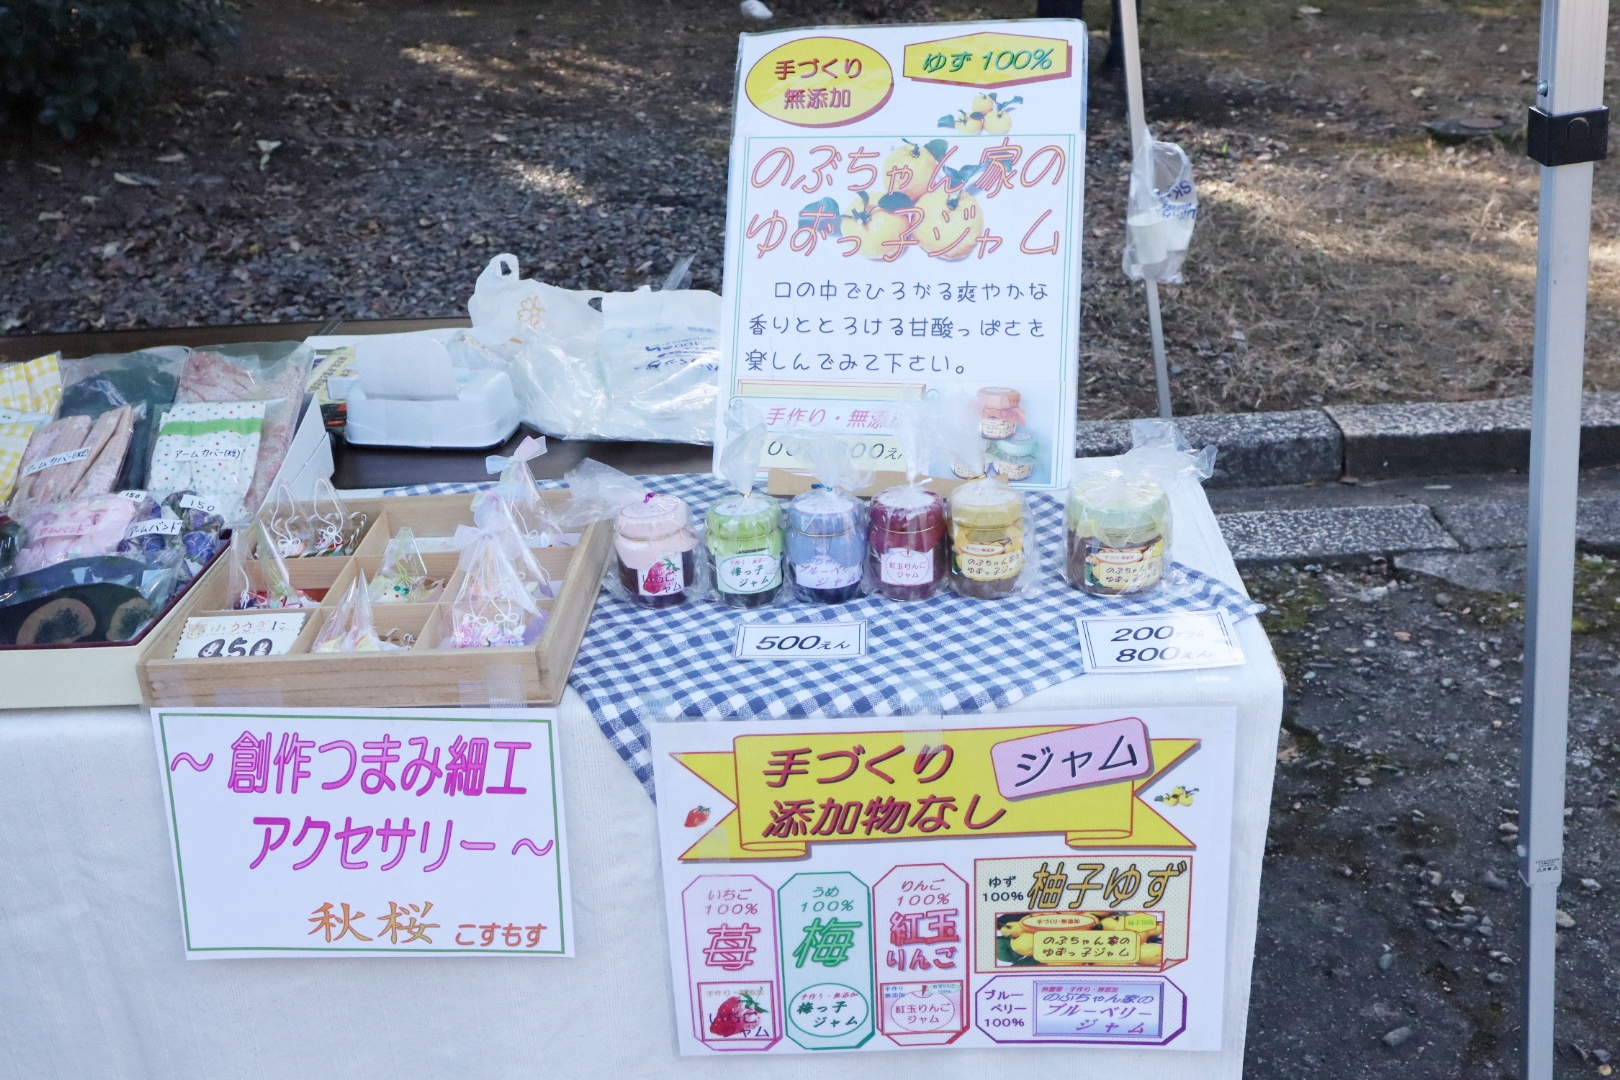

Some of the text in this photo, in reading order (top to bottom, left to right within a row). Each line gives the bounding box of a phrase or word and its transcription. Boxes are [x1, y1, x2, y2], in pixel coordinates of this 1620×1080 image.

[923, 47, 1054, 73] ゆず 100%
[774, 57, 863, 80] 手づくり
[783, 87, 851, 109] 無添加
[750, 137, 1066, 199] のぶちゃん家の
[746, 205, 1060, 263] ゆずっ子ジャム
[774, 279, 1049, 303] 口の中でひろがる爽やかな
[748, 313, 1046, 339] 香りととろける甘酸っぱさを
[744, 348, 965, 376] 楽しんでみて下さい。
[125, 491, 141, 499] 150
[190, 500, 215, 512] 150
[755, 635, 851, 651] 500えん
[762, 743, 956, 788] 手づくり
[1014, 734, 1137, 788] ジャム
[762, 793, 1007, 839] 添加物なし
[901, 878, 946, 893] りんご
[988, 875, 1017, 888] ゆず
[1026, 860, 1188, 910] 柚子ゆず
[707, 888, 753, 901] いちご
[812, 886, 840, 898] うめ
[897, 893, 951, 906] 100%
[982, 892, 1024, 902] 100%
[705, 903, 759, 915] 100%
[800, 900, 854, 912] 100%
[307, 901, 548, 948] 秋桜 こすもす
[889, 908, 961, 947] 紅玉
[703, 922, 761, 972] 苺
[792, 917, 863, 968] 梅
[887, 946, 957, 971] りんご
[984, 990, 1024, 1000] ブルー
[895, 1003, 952, 1014] 紅玉りんご
[990, 1003, 1028, 1013] ベリー
[1042, 1003, 1153, 1020] ブルーベリー
[813, 1016, 858, 1028] ジャム
[907, 1015, 940, 1024] ジャム
[984, 1018, 1025, 1028] 100%
[1076, 1018, 1145, 1034] ジャム
